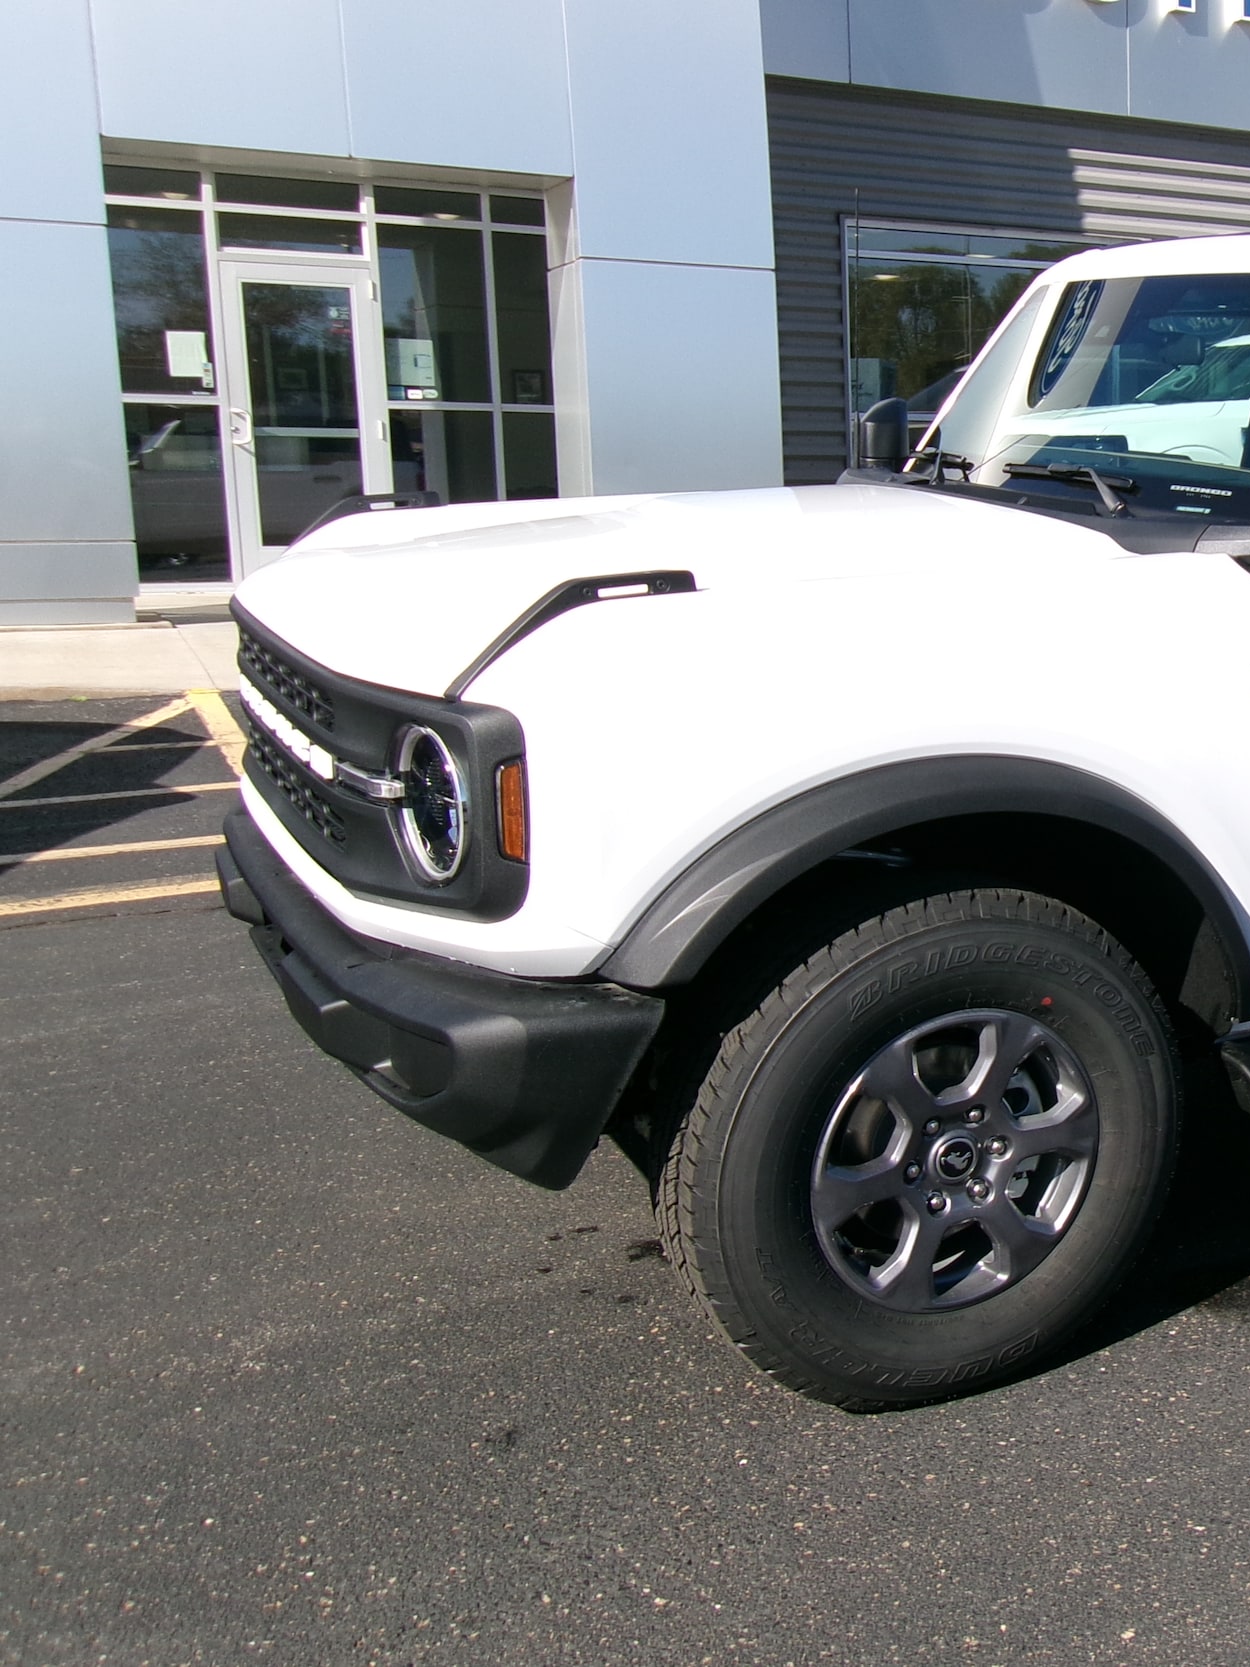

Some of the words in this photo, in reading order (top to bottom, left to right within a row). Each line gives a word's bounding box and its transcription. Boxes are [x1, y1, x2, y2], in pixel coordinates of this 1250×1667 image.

[1169, 484, 1233, 496] BRONCO
[849, 941, 1156, 1057] BRIDGESTONE
[788, 1319, 1040, 1387] DUELER
